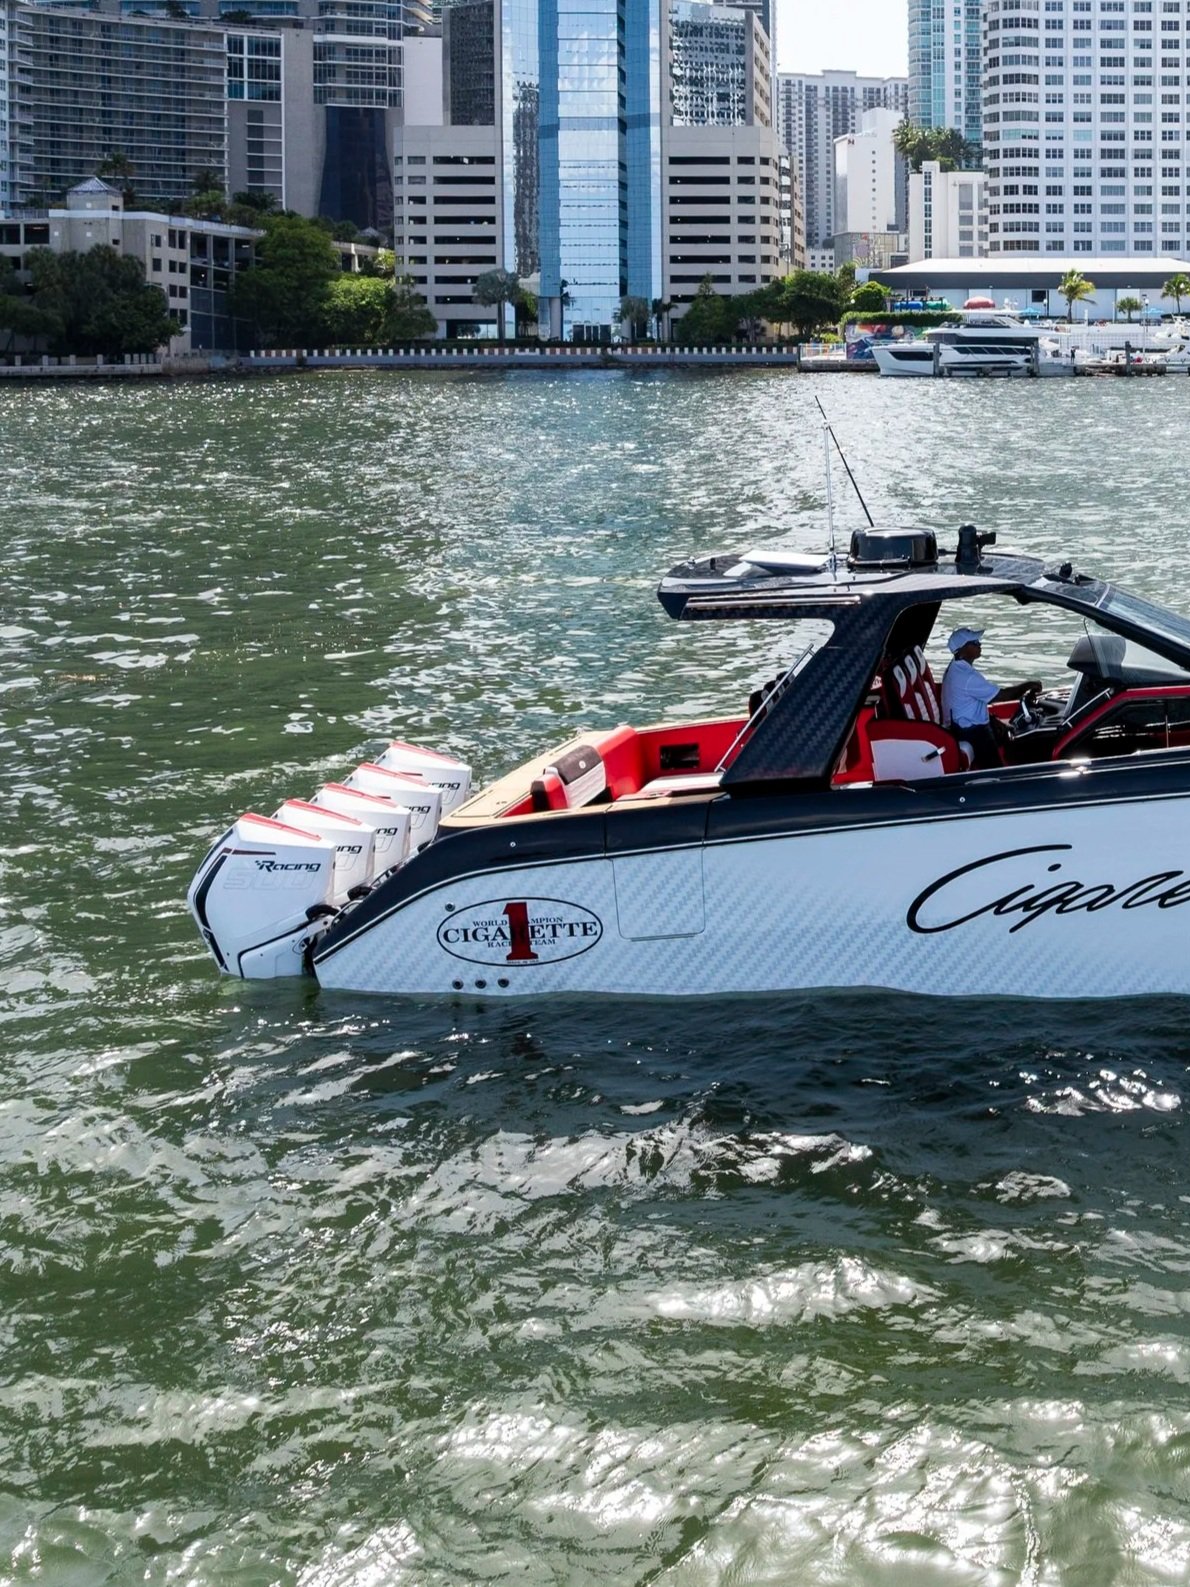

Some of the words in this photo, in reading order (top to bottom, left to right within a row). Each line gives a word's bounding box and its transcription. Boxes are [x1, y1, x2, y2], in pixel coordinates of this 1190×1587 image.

[255, 860, 322, 872] Racing
[472, 919, 508, 927] WORLD
[528, 916, 563, 924] MPION
[443, 921, 598, 944] CIGAETTE
[502, 901, 539, 961] 1
